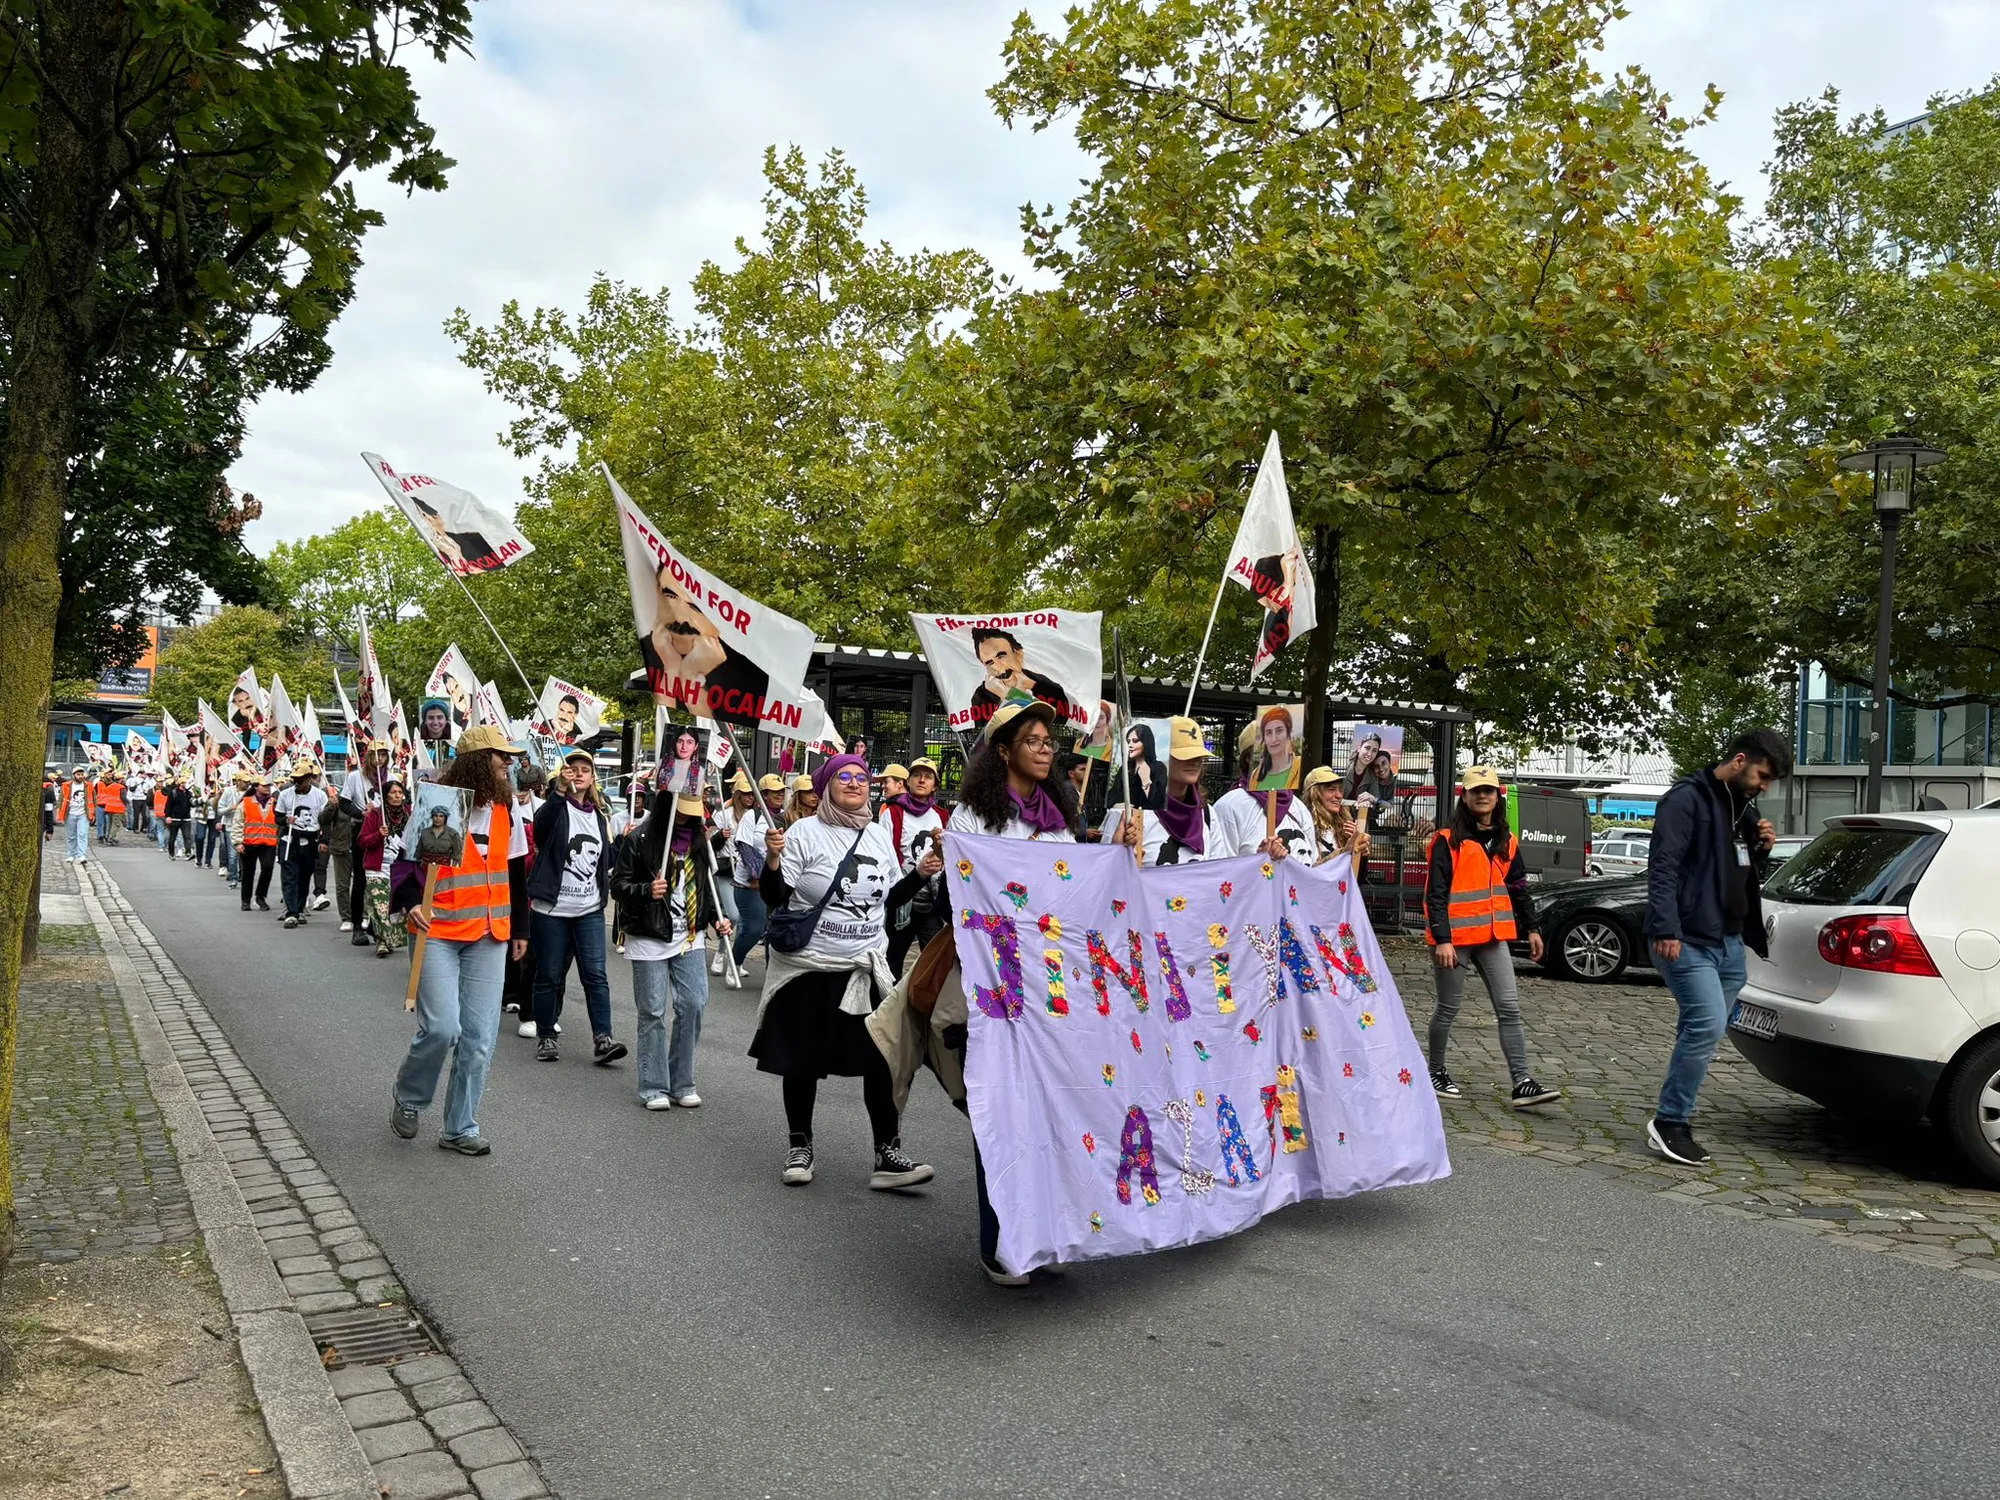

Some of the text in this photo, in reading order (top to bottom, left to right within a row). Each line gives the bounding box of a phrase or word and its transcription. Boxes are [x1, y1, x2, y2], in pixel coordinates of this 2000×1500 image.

[708, 591, 752, 636] FOR
[1024, 613, 1059, 629] FOR
[707, 685, 803, 730] OCALAN
[1521, 829, 1566, 844] Pollmeier
[820, 920, 858, 934] ABDULLAH
